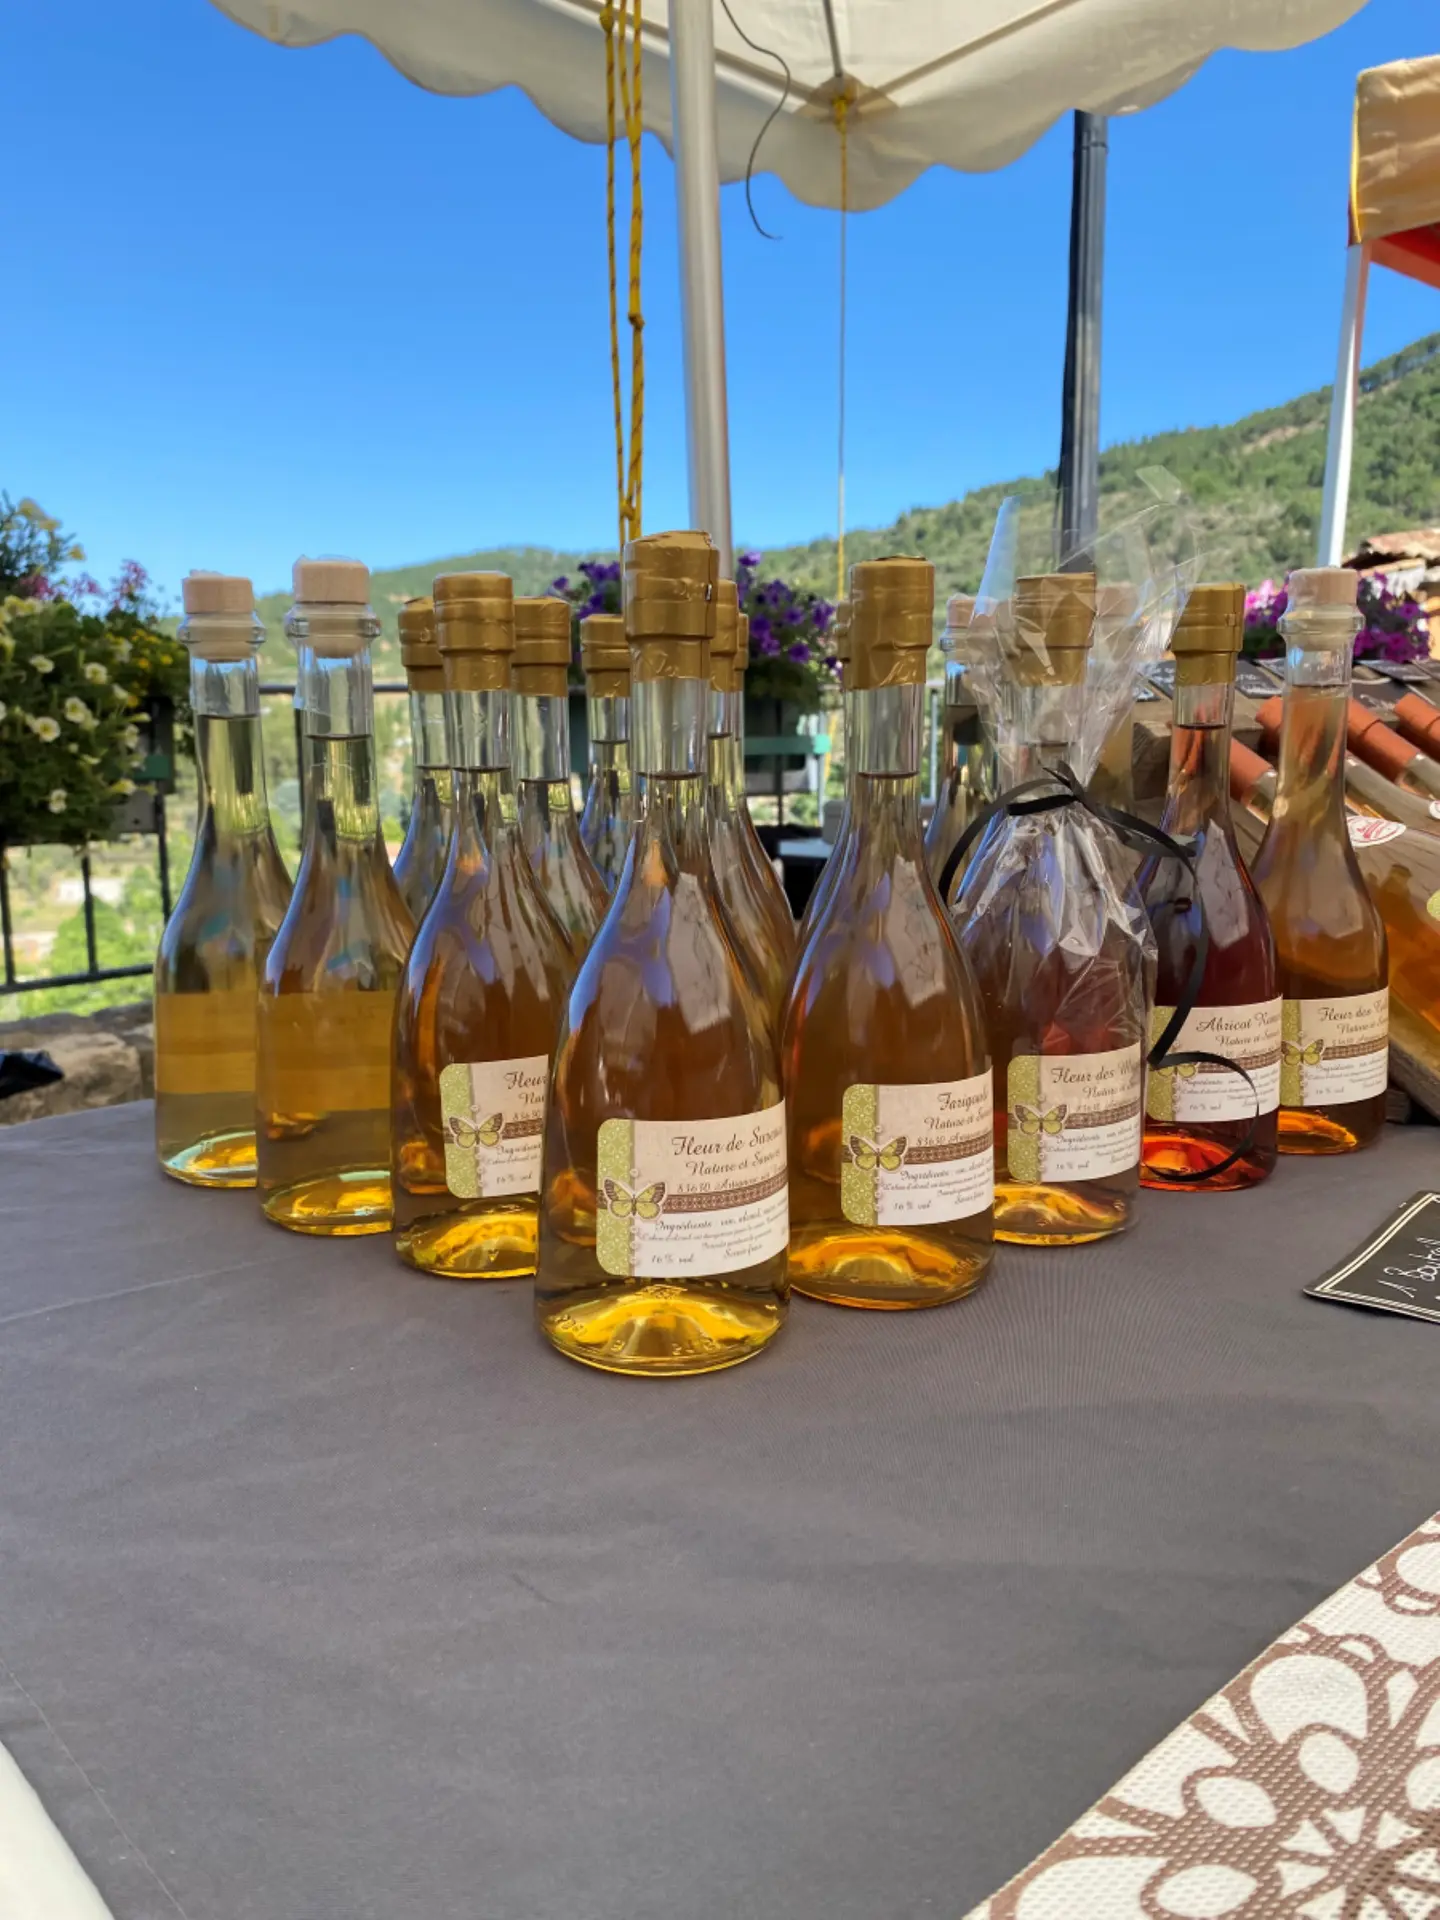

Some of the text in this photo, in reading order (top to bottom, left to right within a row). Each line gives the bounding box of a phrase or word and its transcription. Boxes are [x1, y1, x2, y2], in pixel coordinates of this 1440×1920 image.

[1196, 1017, 1252, 1032] Abricot
[1051, 1066, 1092, 1084] Fleur
[1095, 1065, 1115, 1081] des
[671, 1136, 722, 1156] Fleur
[726, 1133, 744, 1153] de
[685, 1161, 737, 1176] Nature
